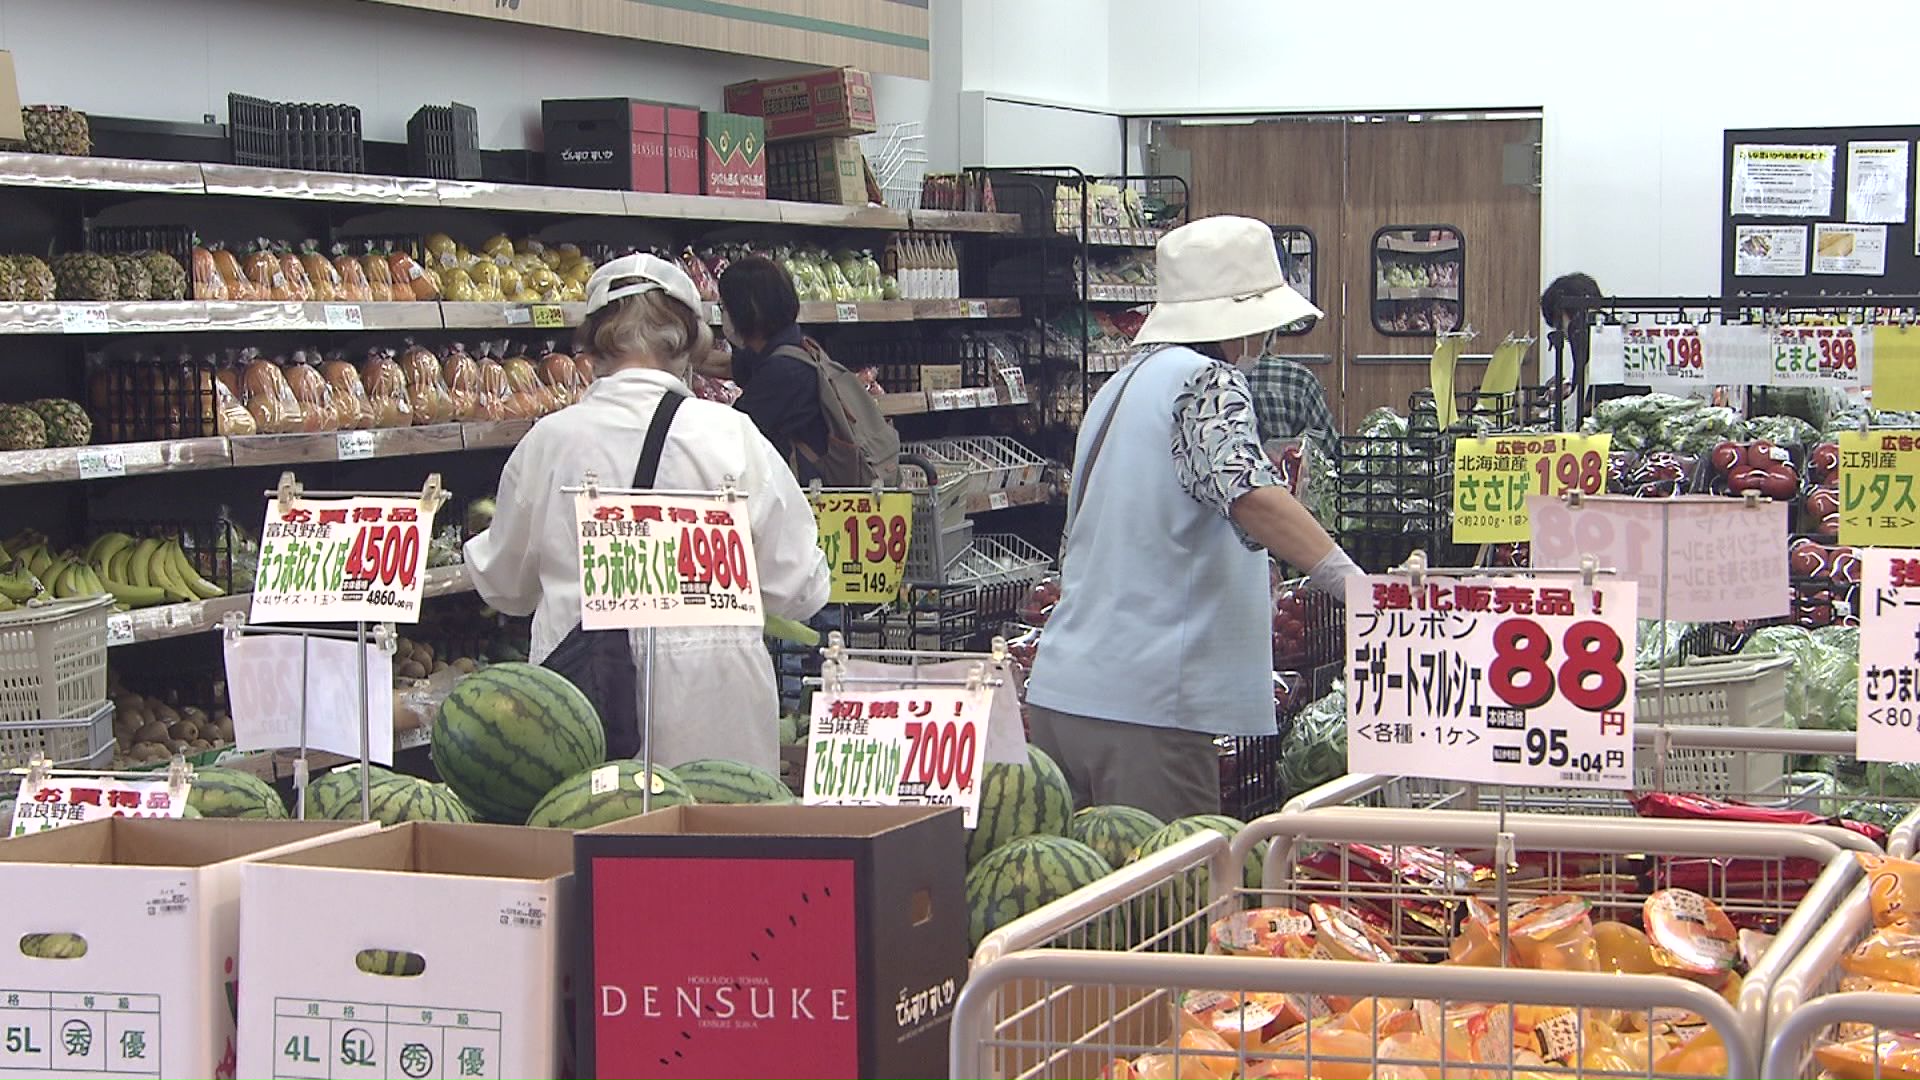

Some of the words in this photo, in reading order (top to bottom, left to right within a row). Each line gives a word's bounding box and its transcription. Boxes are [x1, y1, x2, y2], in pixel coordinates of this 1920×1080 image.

[1624, 345, 1665, 371] ミニトマト
[1667, 338, 1702, 368] 198
[1775, 346, 1817, 372] とまと
[1819, 339, 1857, 370] 398
[1495, 439, 1566, 455] 広告の品！
[1842, 451, 1897, 469] 江別産
[1458, 455, 1528, 472] 北海道産
[1535, 451, 1601, 497] 198
[808, 498, 881, 513] ャンス品！
[1459, 472, 1531, 512] ささげ
[1844, 473, 1917, 512] レタス
[266, 522, 333, 539] 富良野産
[581, 520, 651, 537] 富良野産
[844, 515, 907, 563] 138
[345, 525, 420, 586] 4500
[677, 527, 748, 590] 4980
[1372, 583, 1602, 616] 強化販売品！
[1355, 611, 1477, 640] ブルボン
[1354, 641, 1482, 718] デザートマルシェ
[1488, 618, 1628, 712] 88
[817, 717, 869, 735] 当麻産
[814, 737, 900, 797] でんすけすいか
[902, 721, 976, 790] 7000
[18, 801, 86, 821] 富良野産
[600, 985, 851, 1020] DENSUKE
[6, 1026, 42, 1053] 5L
[65, 1028, 92, 1057] 秀
[119, 1029, 146, 1059] 優
[284, 1035, 321, 1063] 4L
[340, 1038, 377, 1067] 5L
[403, 1043, 428, 1072] 秀
[457, 1046, 485, 1077] 優
